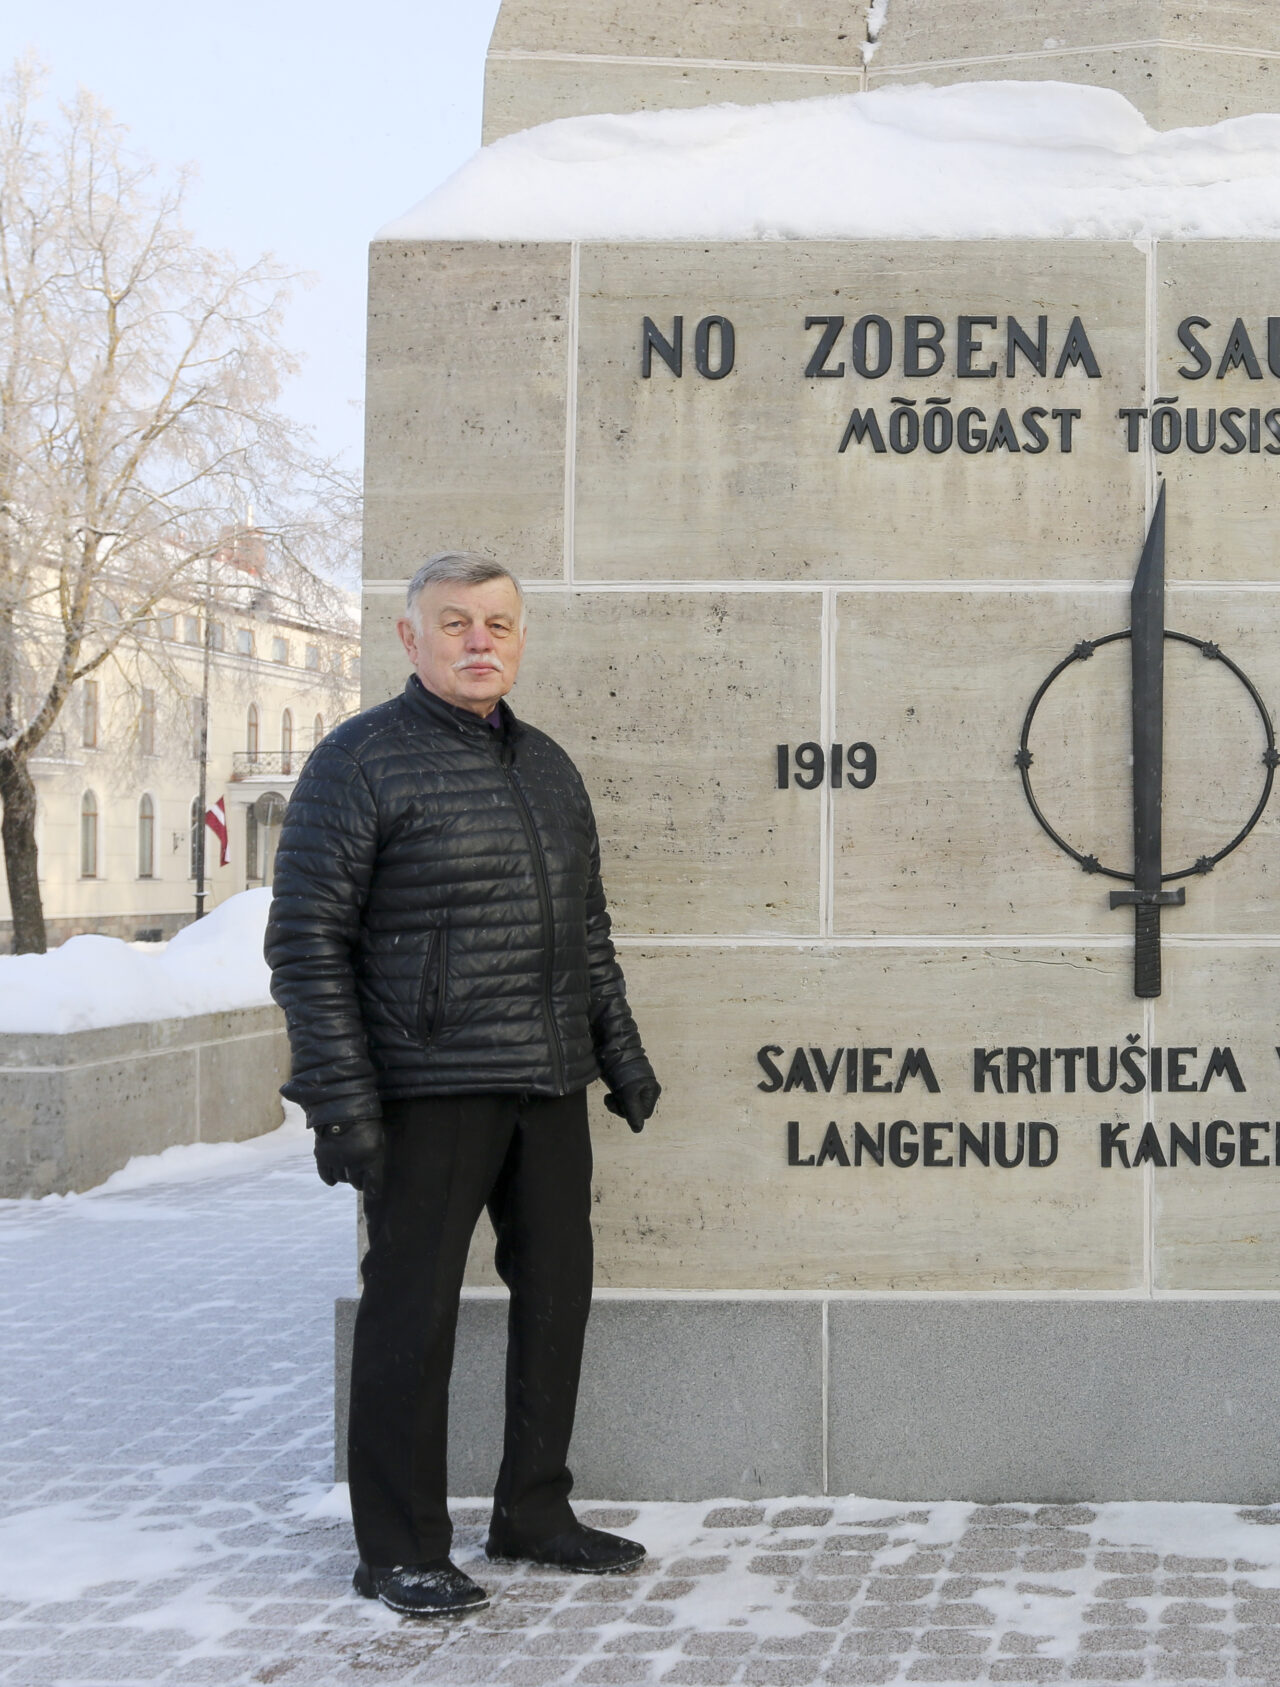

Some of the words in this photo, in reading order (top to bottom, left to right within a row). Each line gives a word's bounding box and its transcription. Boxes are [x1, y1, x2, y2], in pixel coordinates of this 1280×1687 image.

[642, 315, 735, 380] NO
[804, 315, 1102, 379] ZOBENA
[838, 396, 1081, 454] MÕÕGAST
[777, 741, 877, 790] 1919
[757, 1045, 941, 1094] SAVIEM
[974, 1033, 1246, 1094] KRITUŠIEM
[788, 1119, 1058, 1169] LANGENUD
